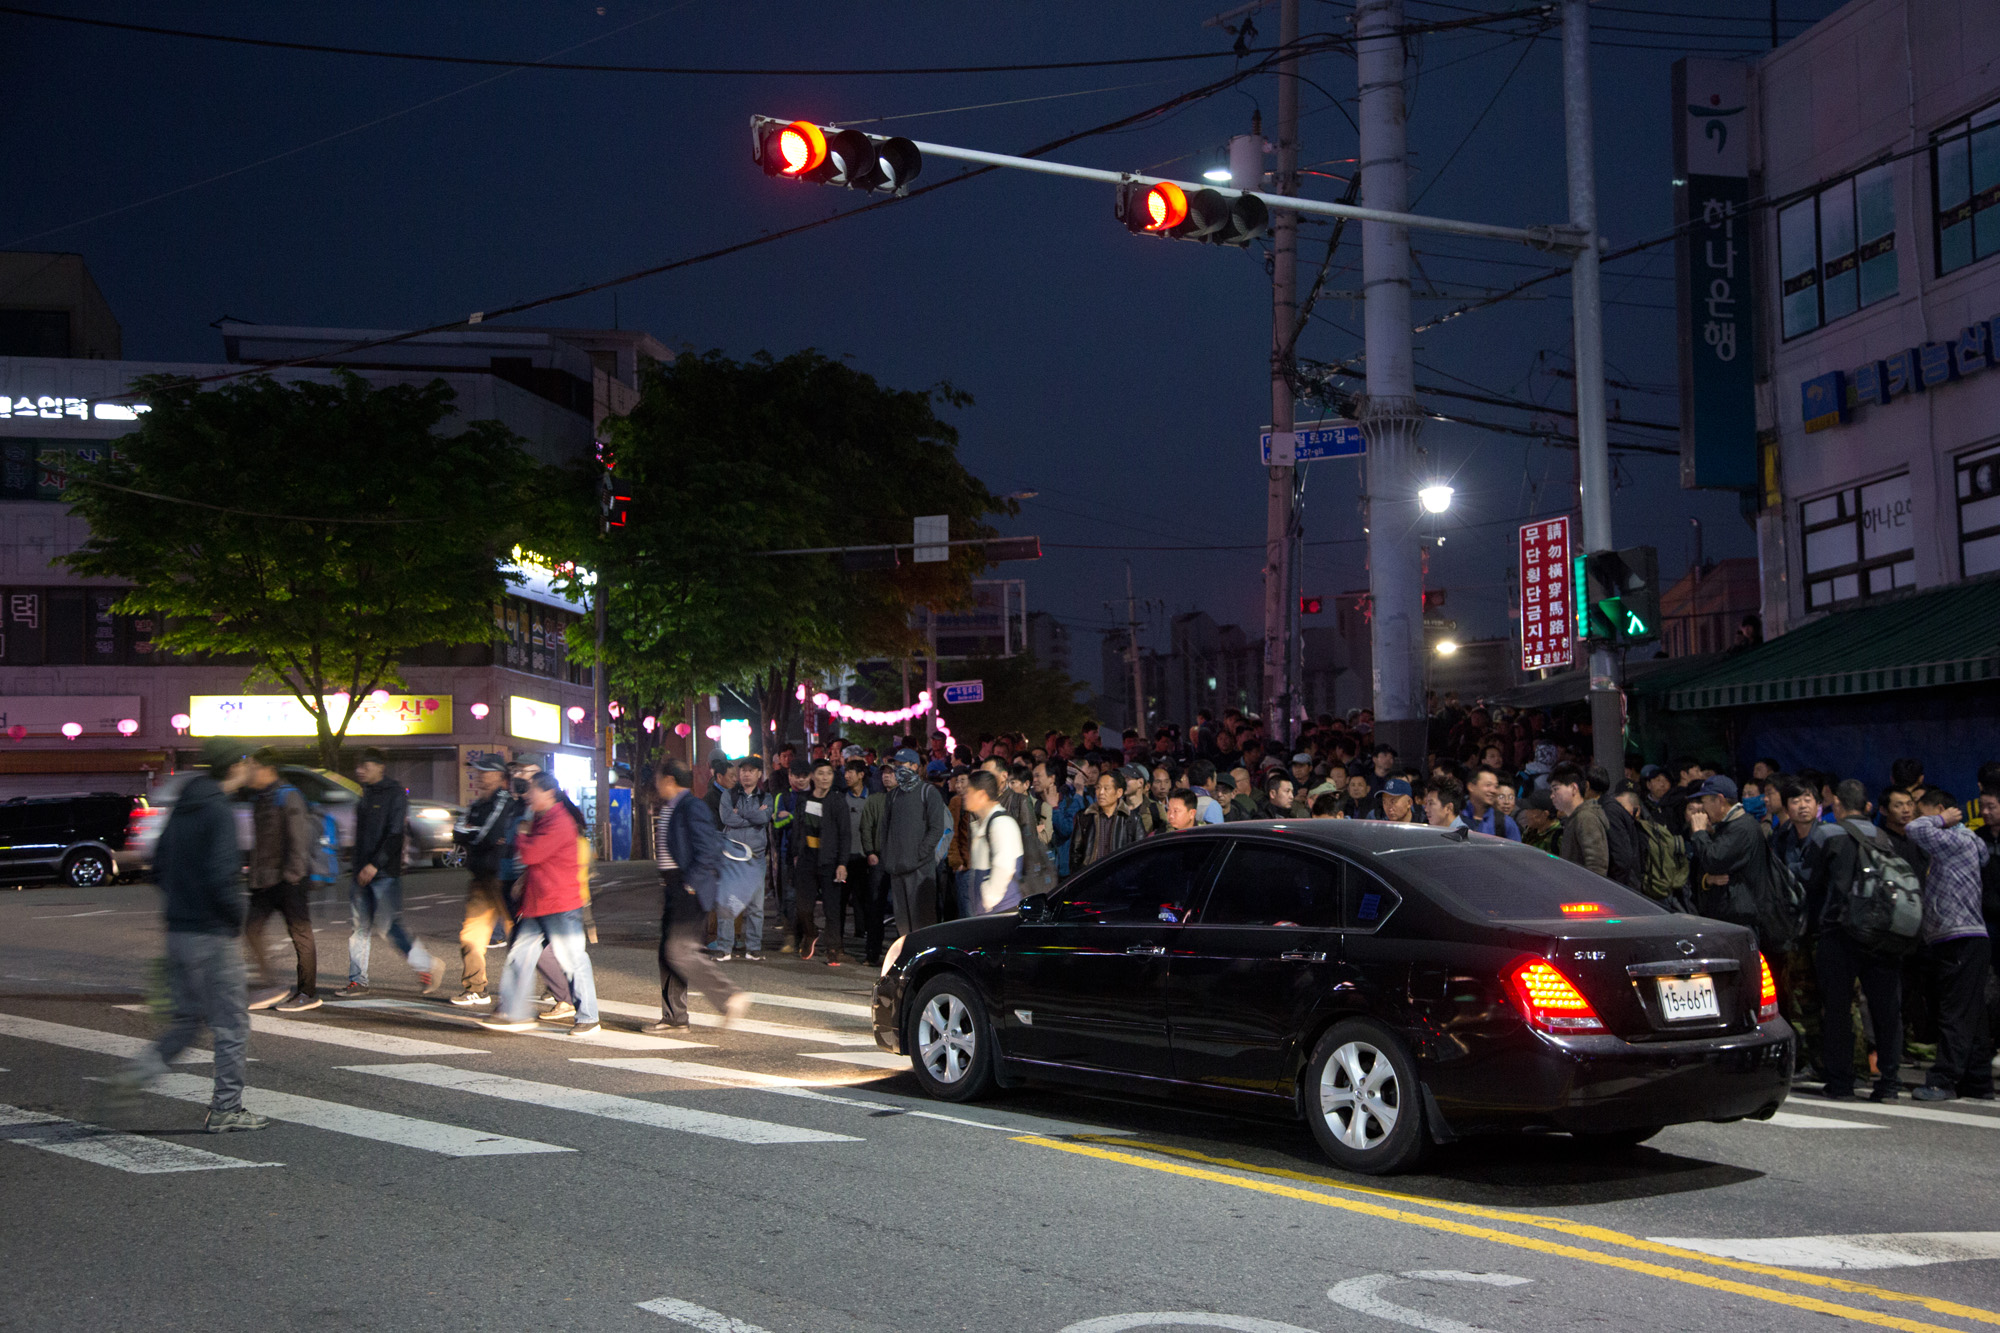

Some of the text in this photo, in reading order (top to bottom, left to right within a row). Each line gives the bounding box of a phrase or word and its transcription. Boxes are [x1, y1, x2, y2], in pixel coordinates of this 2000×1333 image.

[1703, 198, 1737, 361] 하나은행
[1525, 528, 1542, 638] 무단횡단금지
[1546, 522, 1564, 636] 請勿橫穿馬路
[1525, 651, 1569, 667] 구로경찰서
[1574, 950, 1606, 961] SM5
[1665, 989, 1713, 1012] 15수6617
